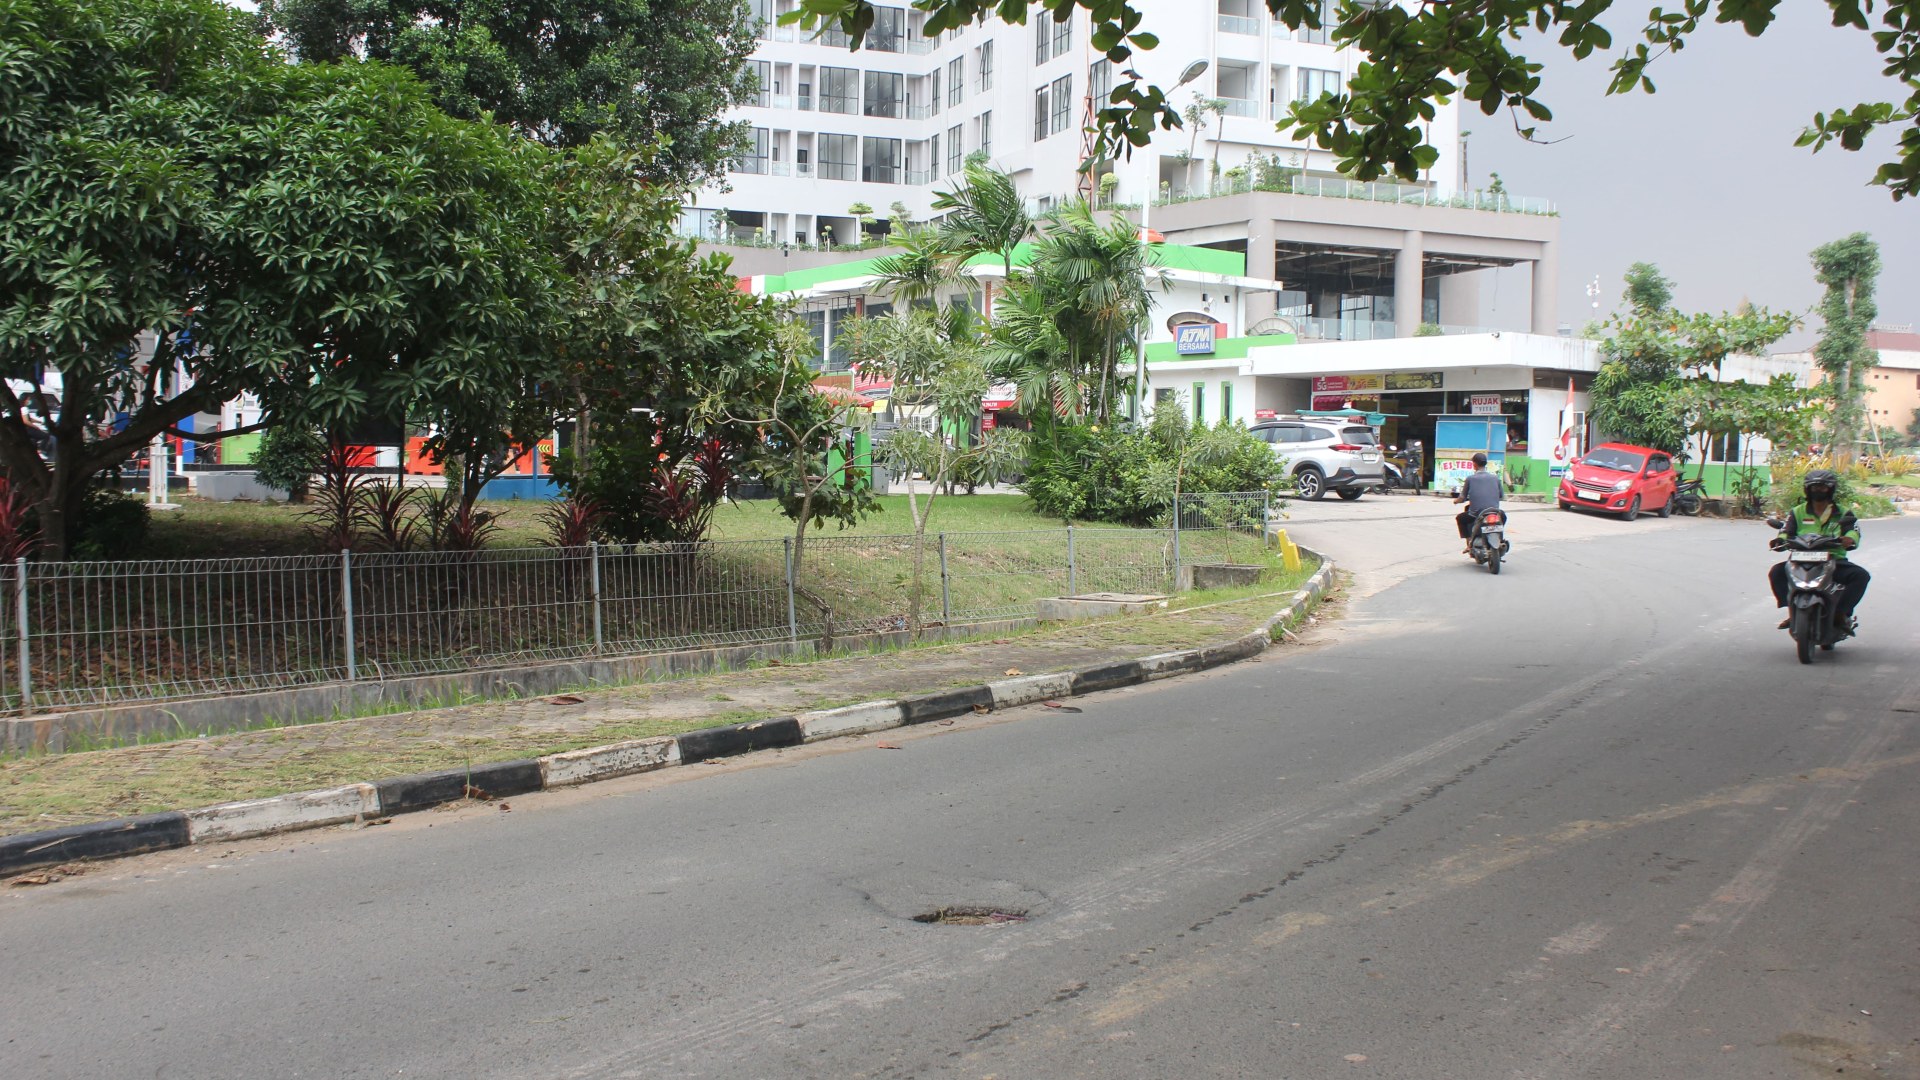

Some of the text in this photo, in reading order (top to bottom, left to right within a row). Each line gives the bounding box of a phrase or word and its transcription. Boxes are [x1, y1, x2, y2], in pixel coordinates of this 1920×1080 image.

[1179, 328, 1210, 342] ATM
[1178, 342, 1210, 351] BERSAMA
[1472, 397, 1499, 405] RUJAK
[1443, 461, 1473, 470] ES TEB
